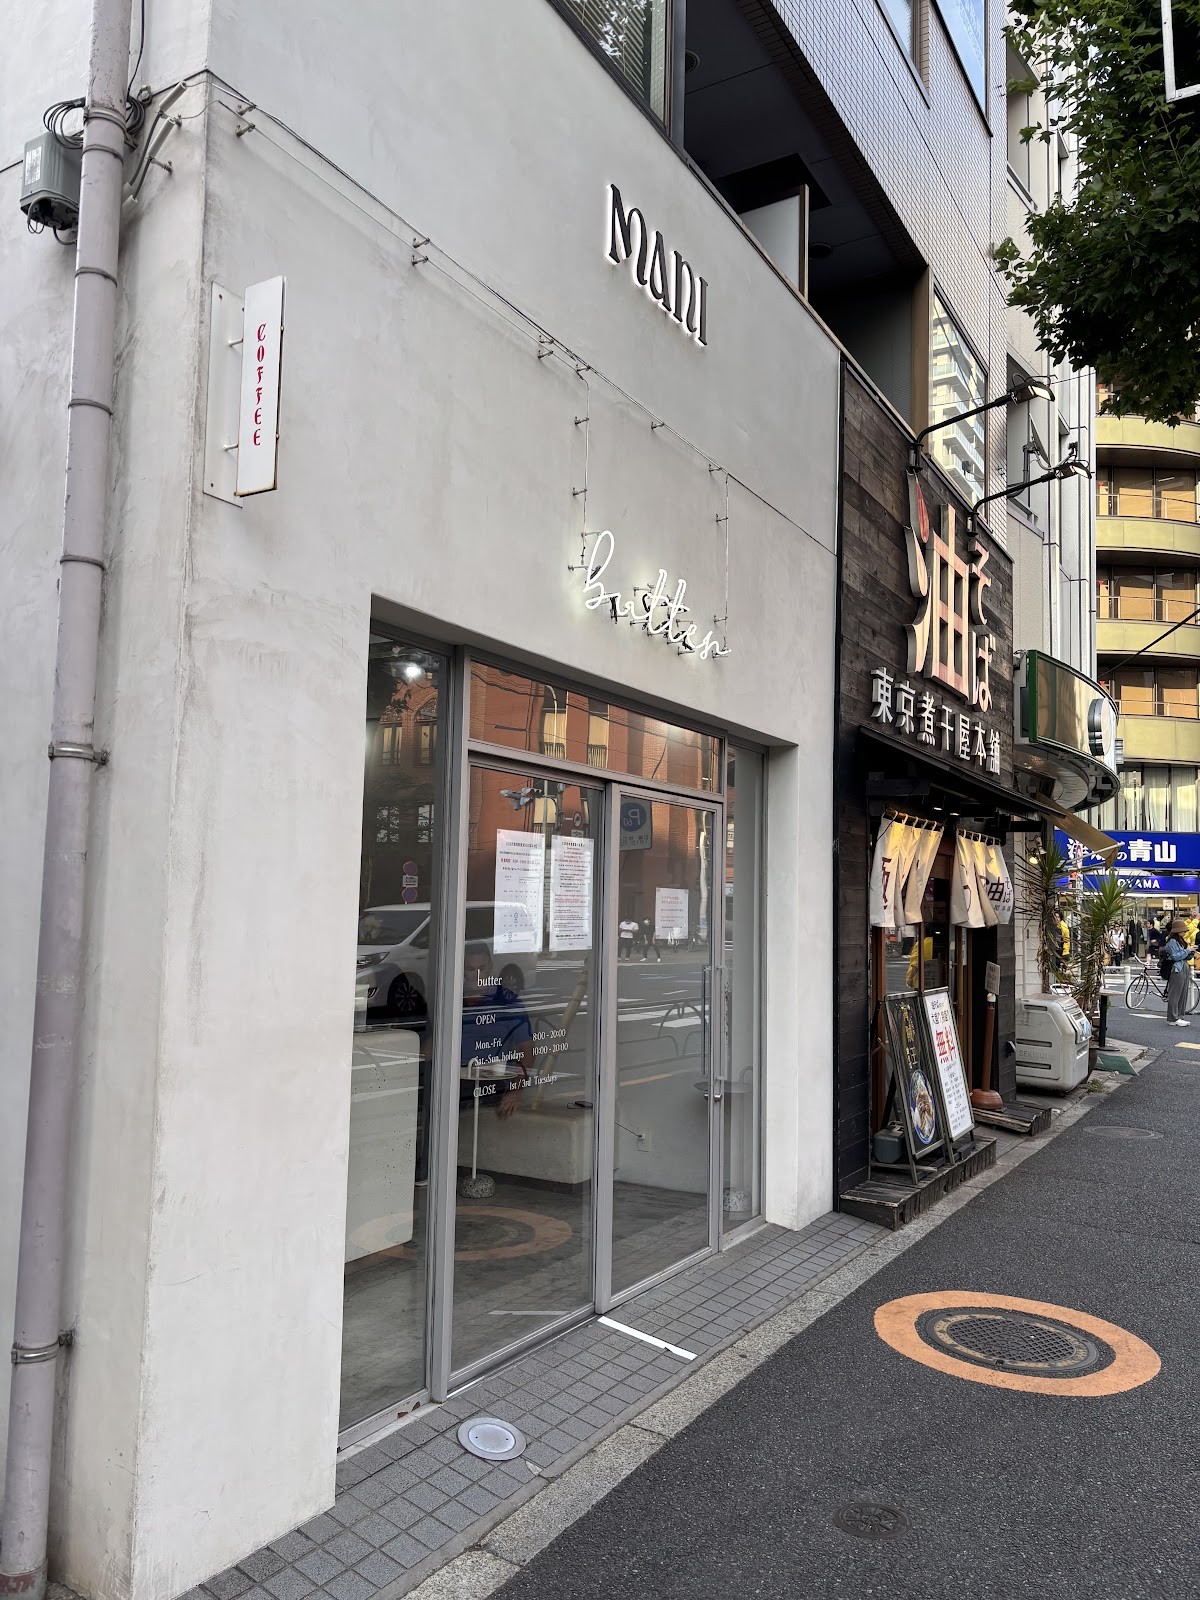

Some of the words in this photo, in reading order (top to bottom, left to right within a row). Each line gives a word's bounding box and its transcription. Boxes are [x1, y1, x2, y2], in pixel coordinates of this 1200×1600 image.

[253, 323, 267, 446] COFFEE
[583, 530, 732, 660] butter
[871, 666, 1001, 776] 東京煮干屋本舗
[477, 969, 503, 987] butter
[475, 1014, 496, 1025] OPEN
[501, 1049, 525, 1062] holidays
[473, 1084, 496, 1098] CLOSE
